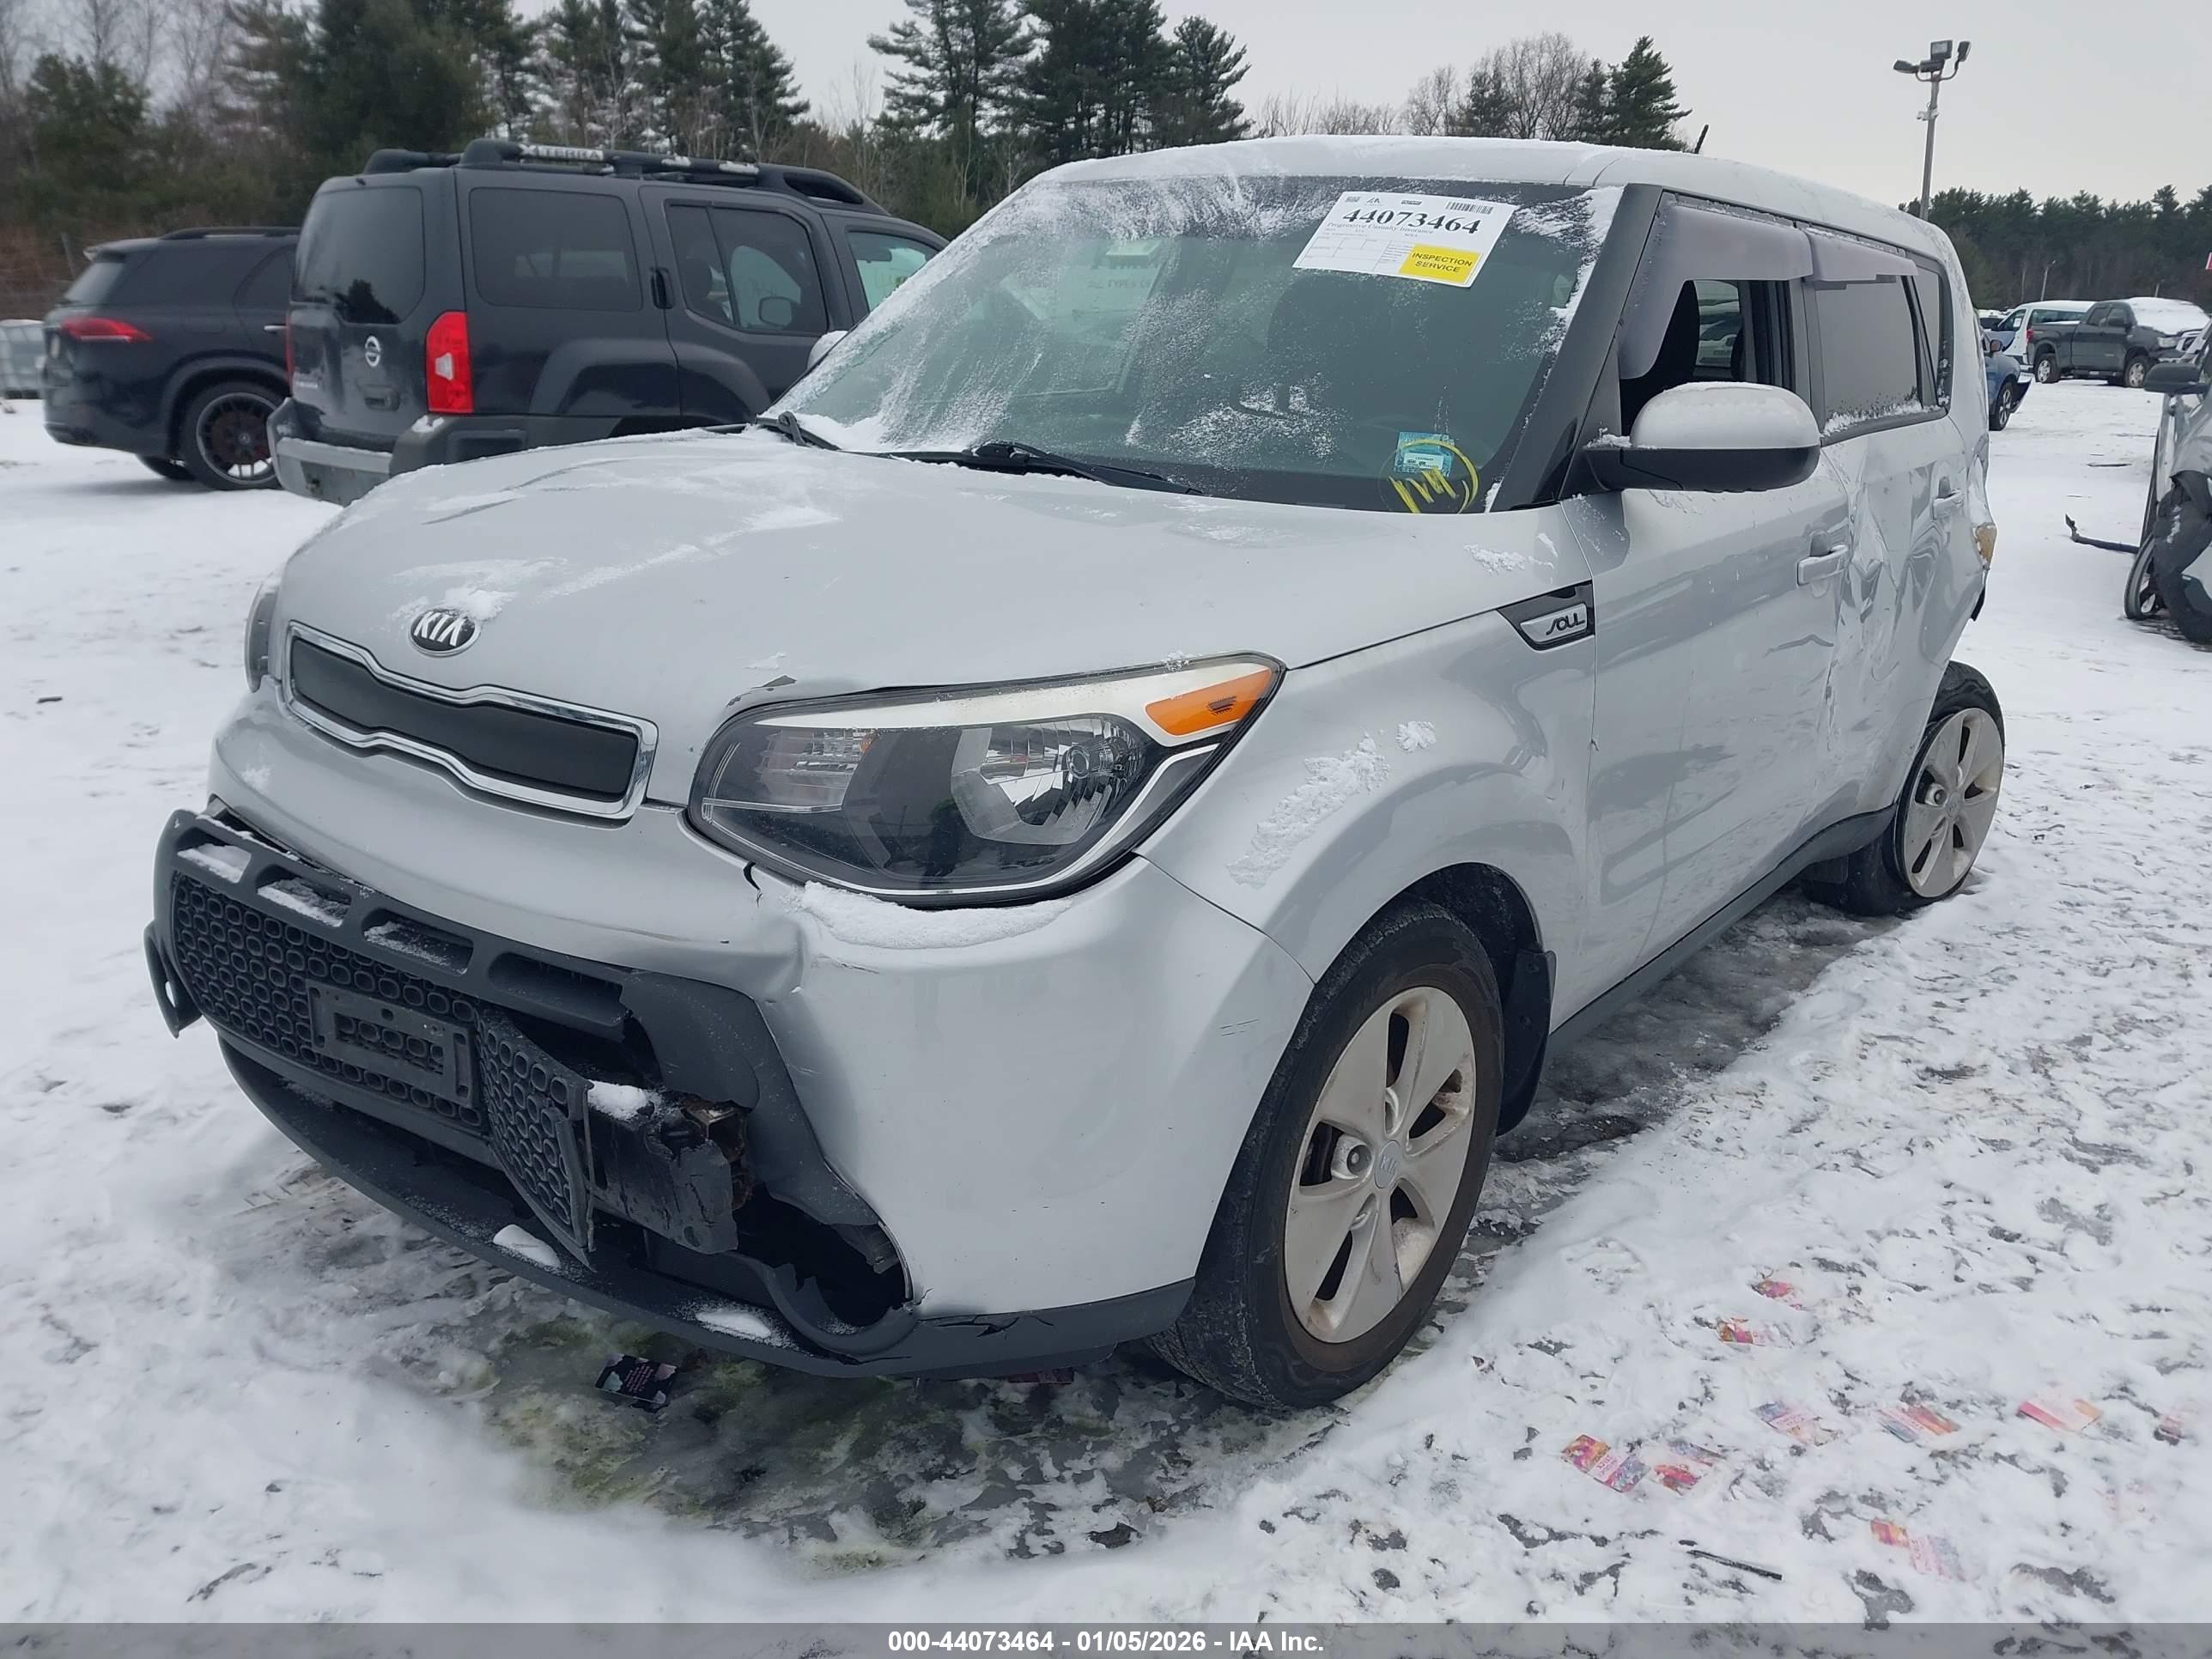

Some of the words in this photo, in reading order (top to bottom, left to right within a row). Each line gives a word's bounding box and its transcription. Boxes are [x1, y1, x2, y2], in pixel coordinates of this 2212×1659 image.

[1343, 208, 1482, 234] 44073464
[1412, 252, 1474, 267] INSPECTION
[1414, 260, 1462, 273] SERVICE
[413, 610, 467, 647] KIA
[1546, 612, 1585, 635] SOUL
